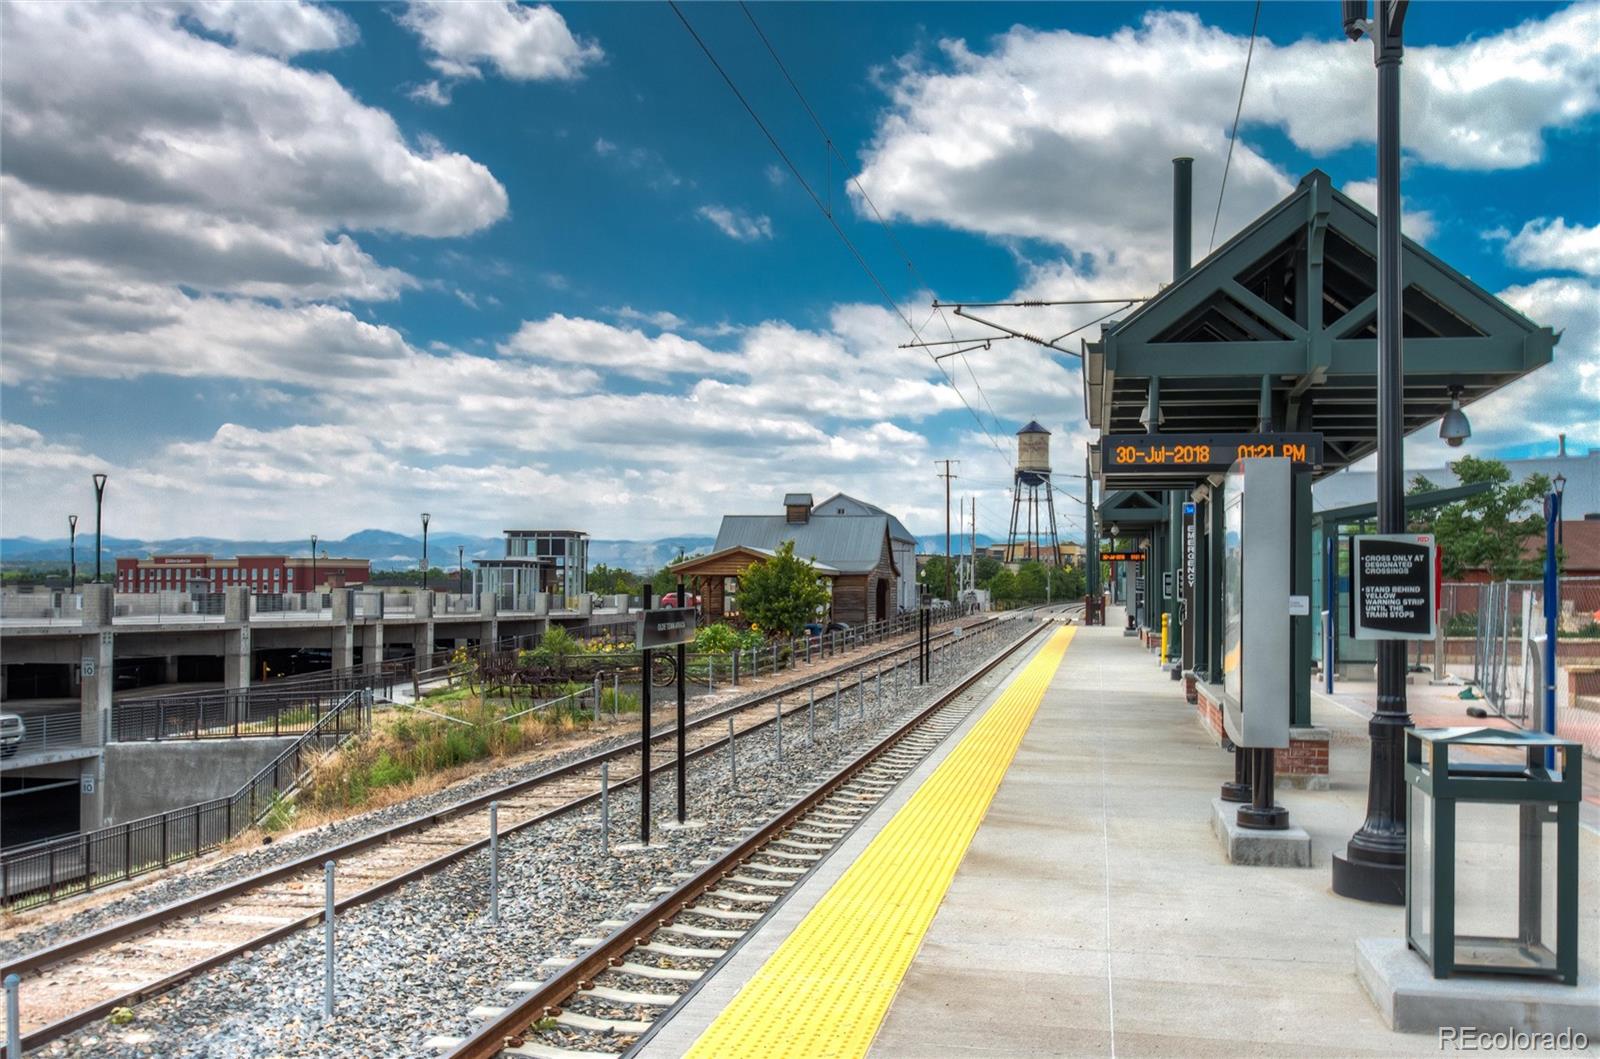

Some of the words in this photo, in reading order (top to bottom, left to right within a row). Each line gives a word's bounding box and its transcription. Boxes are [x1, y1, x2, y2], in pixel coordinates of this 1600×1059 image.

[1116, 445, 1210, 463] 30-Jul-2018
[1237, 445, 1275, 460] 01:21
[1283, 444, 1306, 462] PM
[1187, 525, 1196, 587] EMERGENCY
